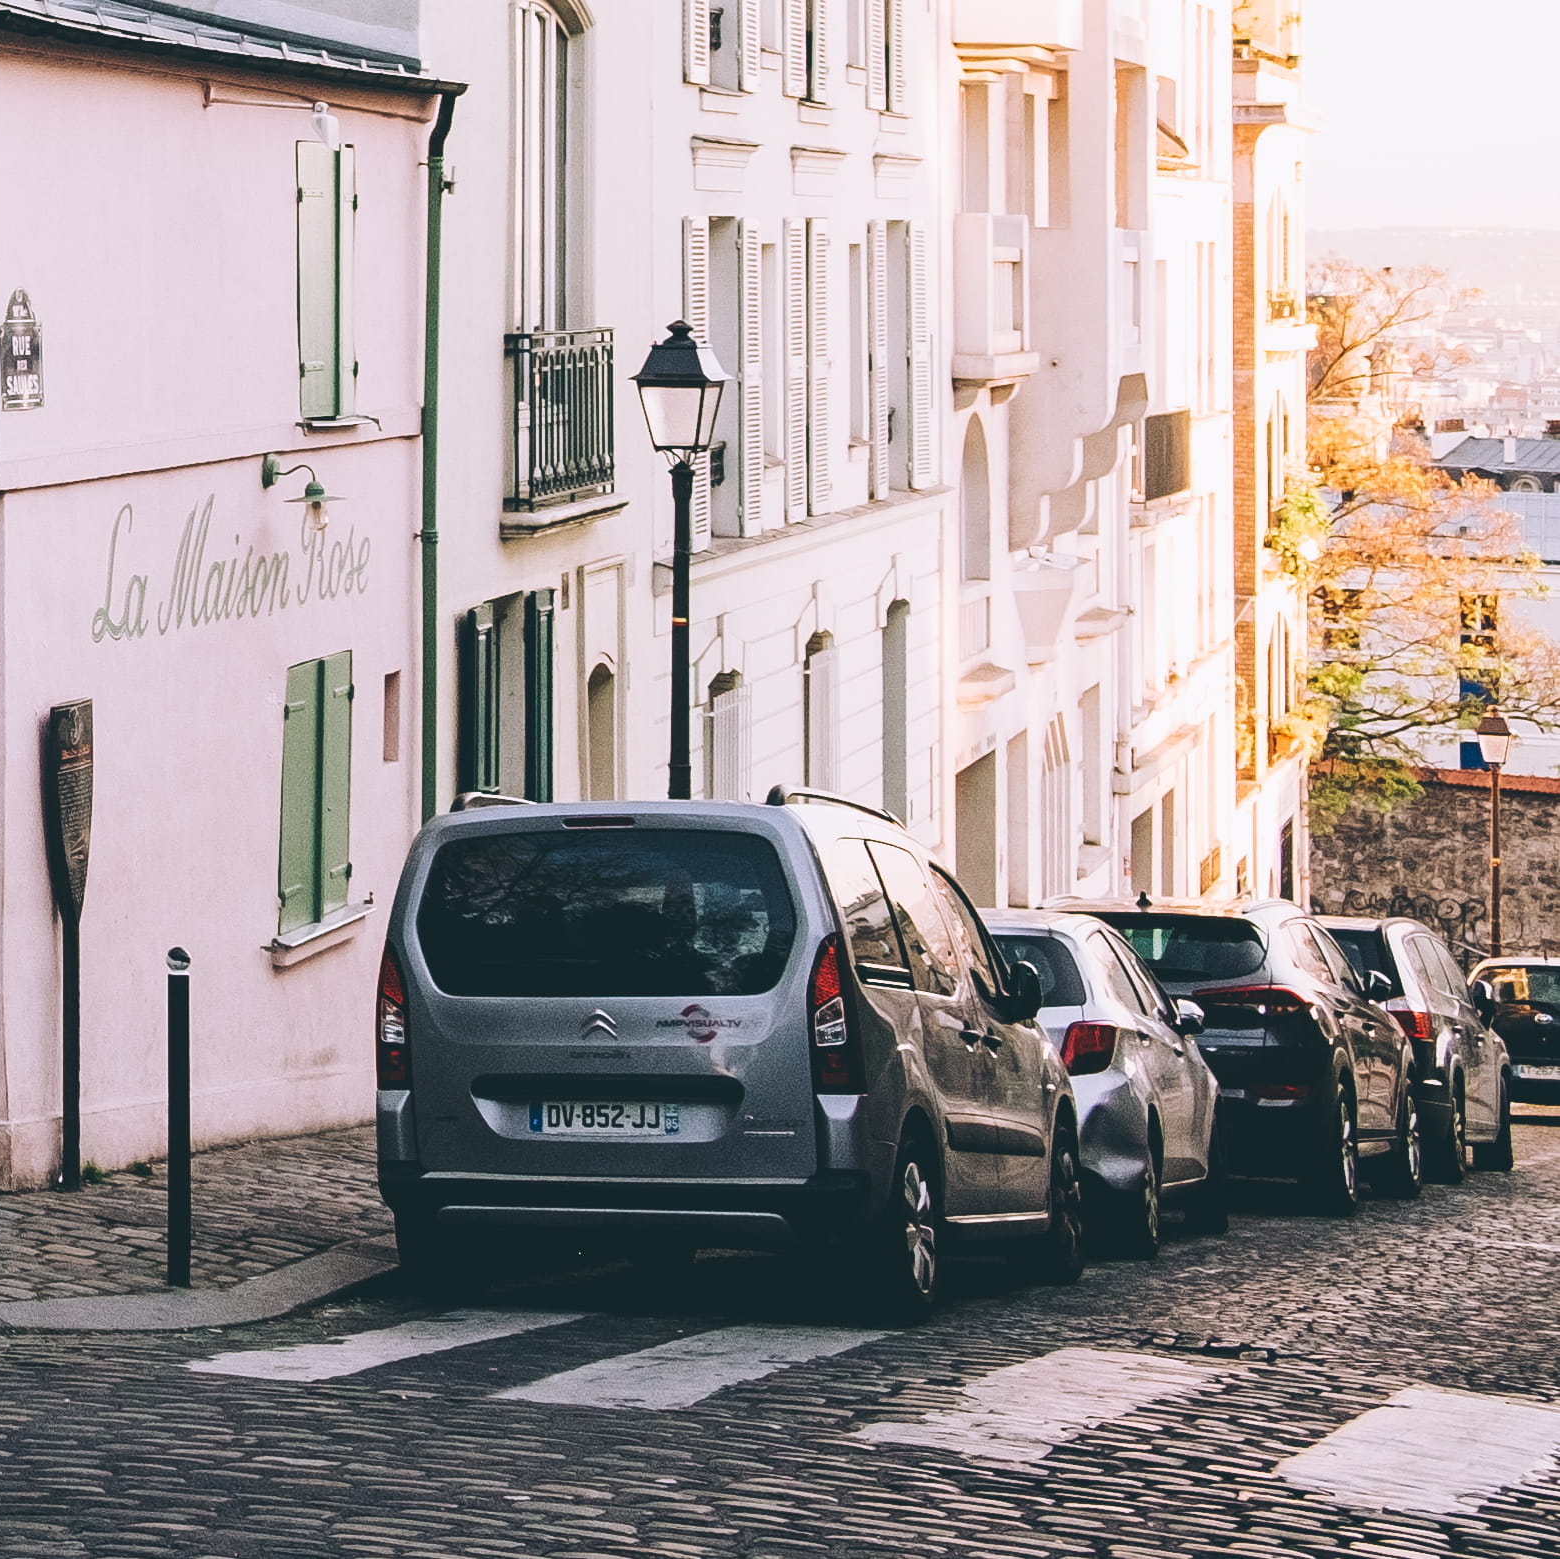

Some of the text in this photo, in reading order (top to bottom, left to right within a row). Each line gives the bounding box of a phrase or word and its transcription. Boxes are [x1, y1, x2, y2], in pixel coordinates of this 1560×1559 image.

[12, 335, 31, 356] RUE
[92, 493, 371, 643] La Maison Rose
[547, 1104, 660, 1129] DV-852-JJ
[665, 1118, 679, 1130] 85
